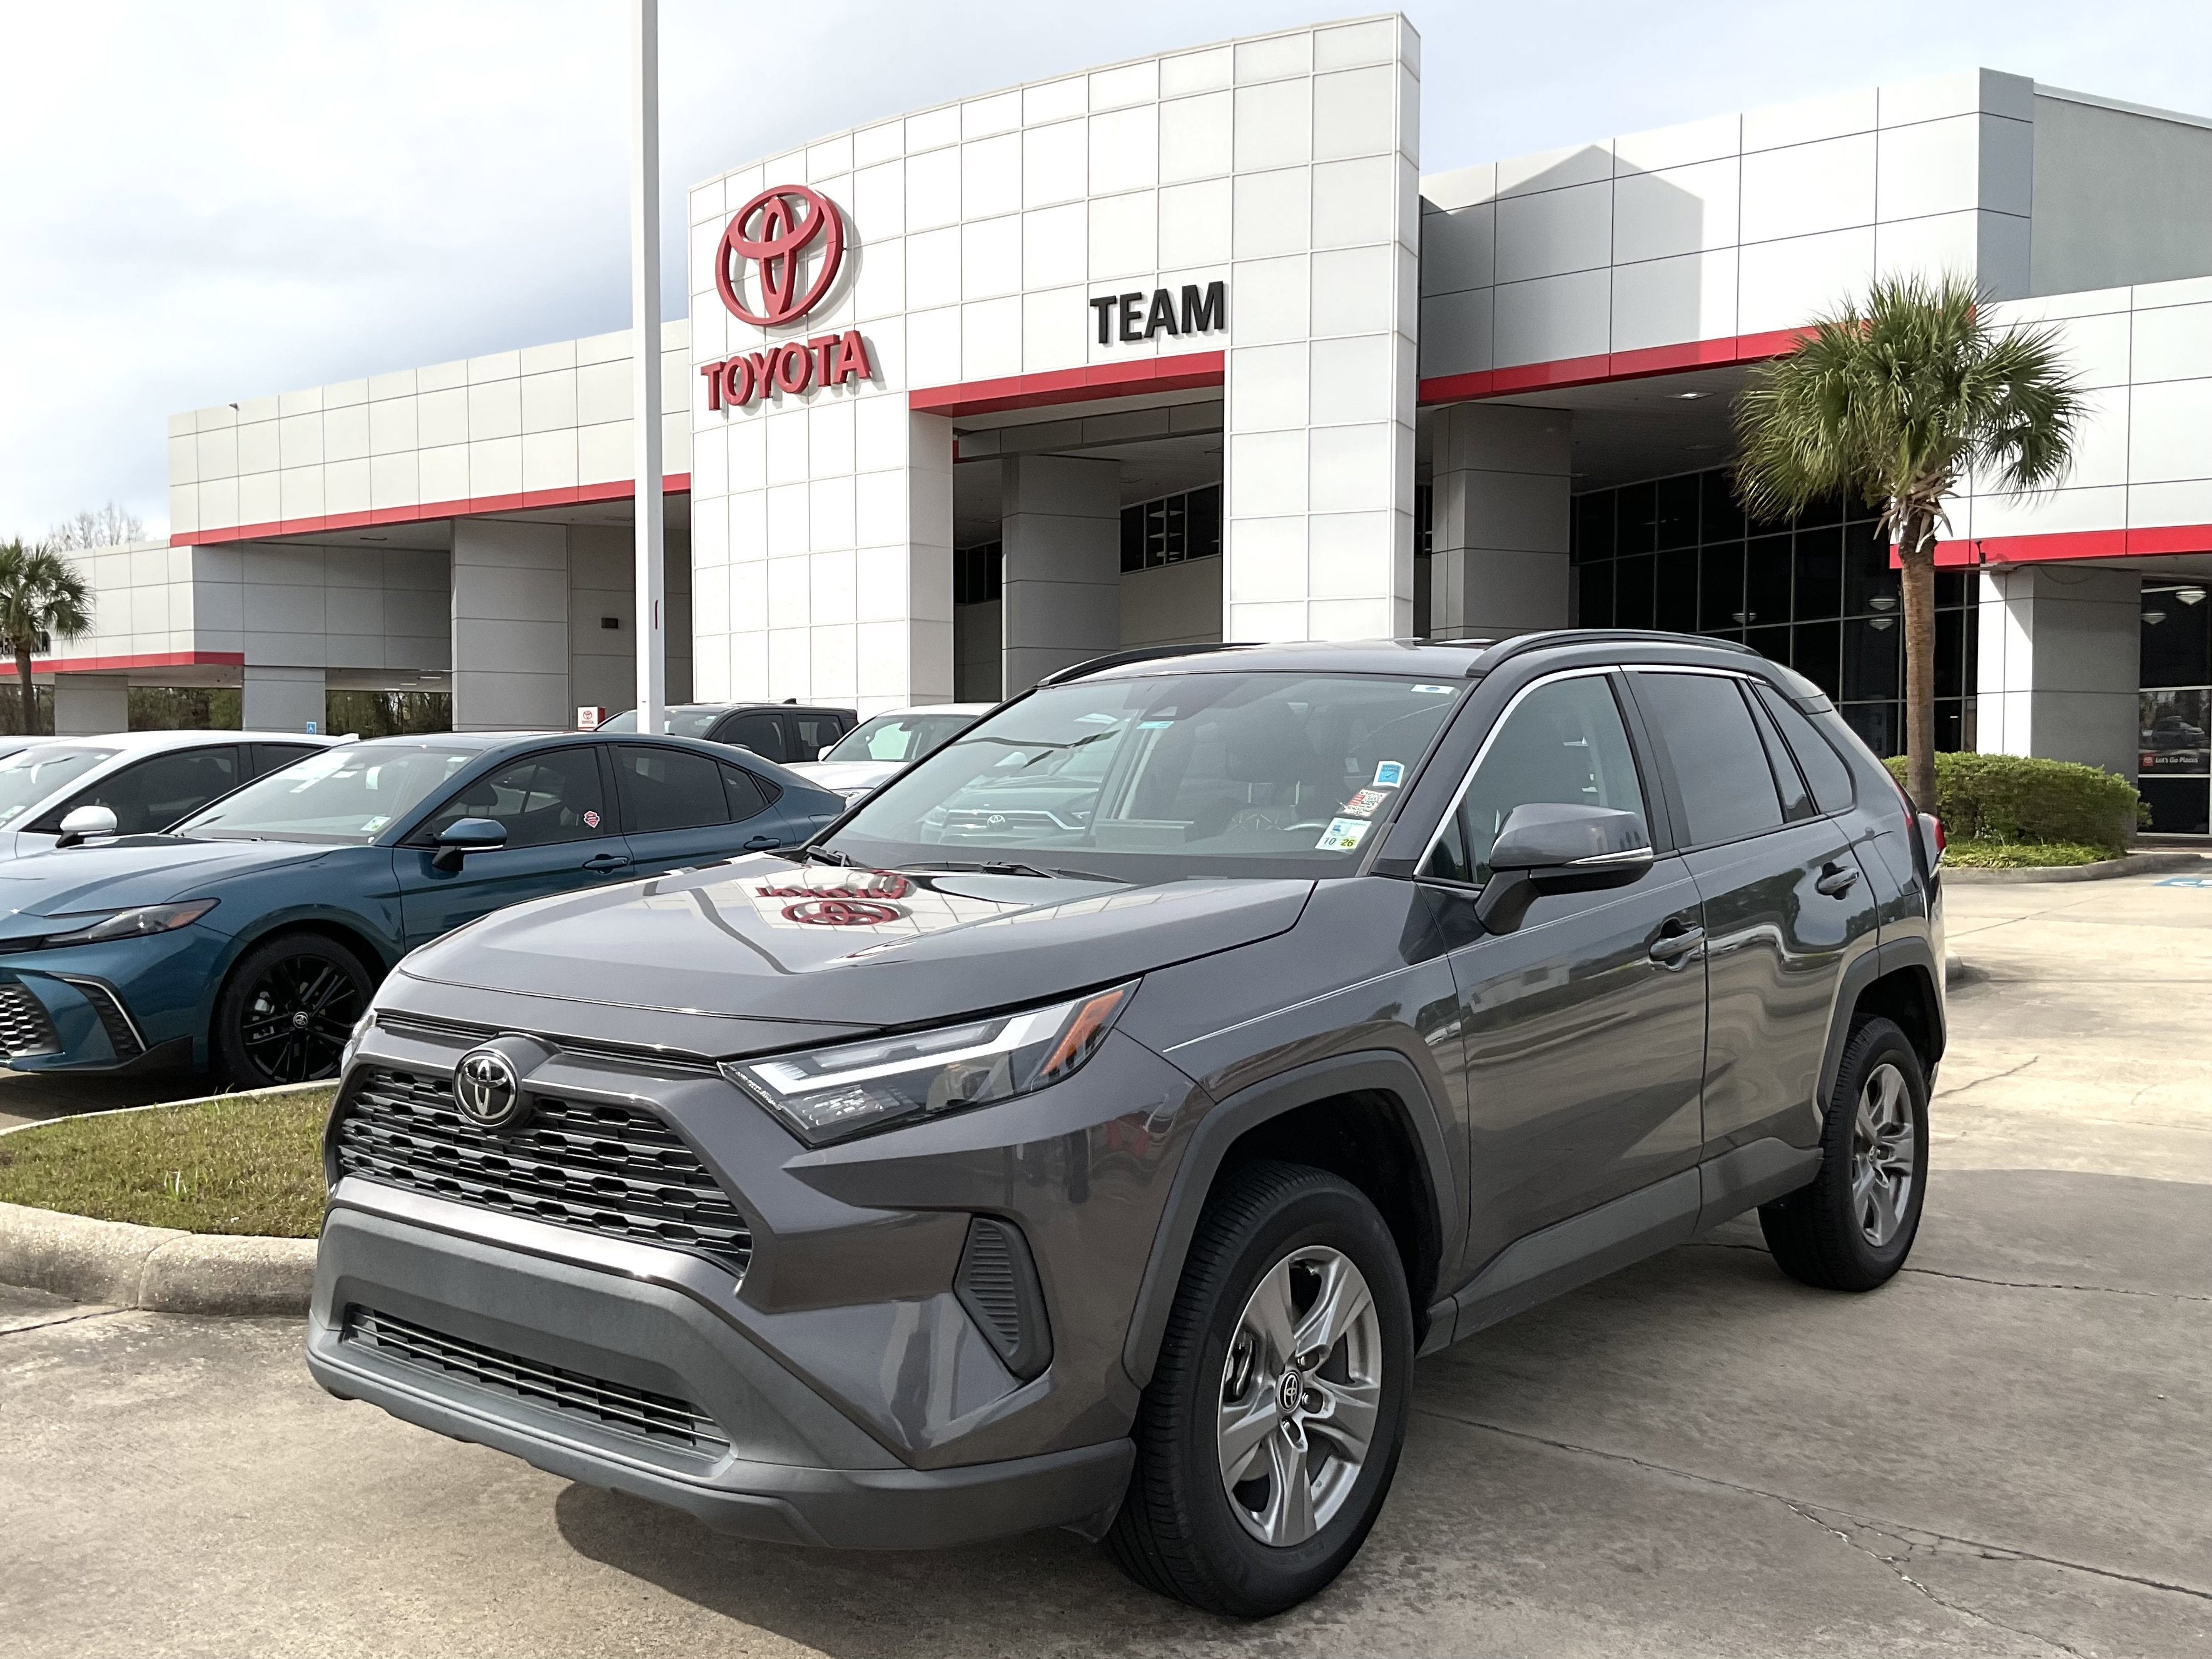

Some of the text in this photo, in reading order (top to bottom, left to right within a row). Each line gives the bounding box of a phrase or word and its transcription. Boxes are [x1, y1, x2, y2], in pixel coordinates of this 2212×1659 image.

[1090, 281, 1224, 343] TEAM
[701, 330, 871, 411] TOYOTA
[1324, 837, 1355, 846] 10 26
